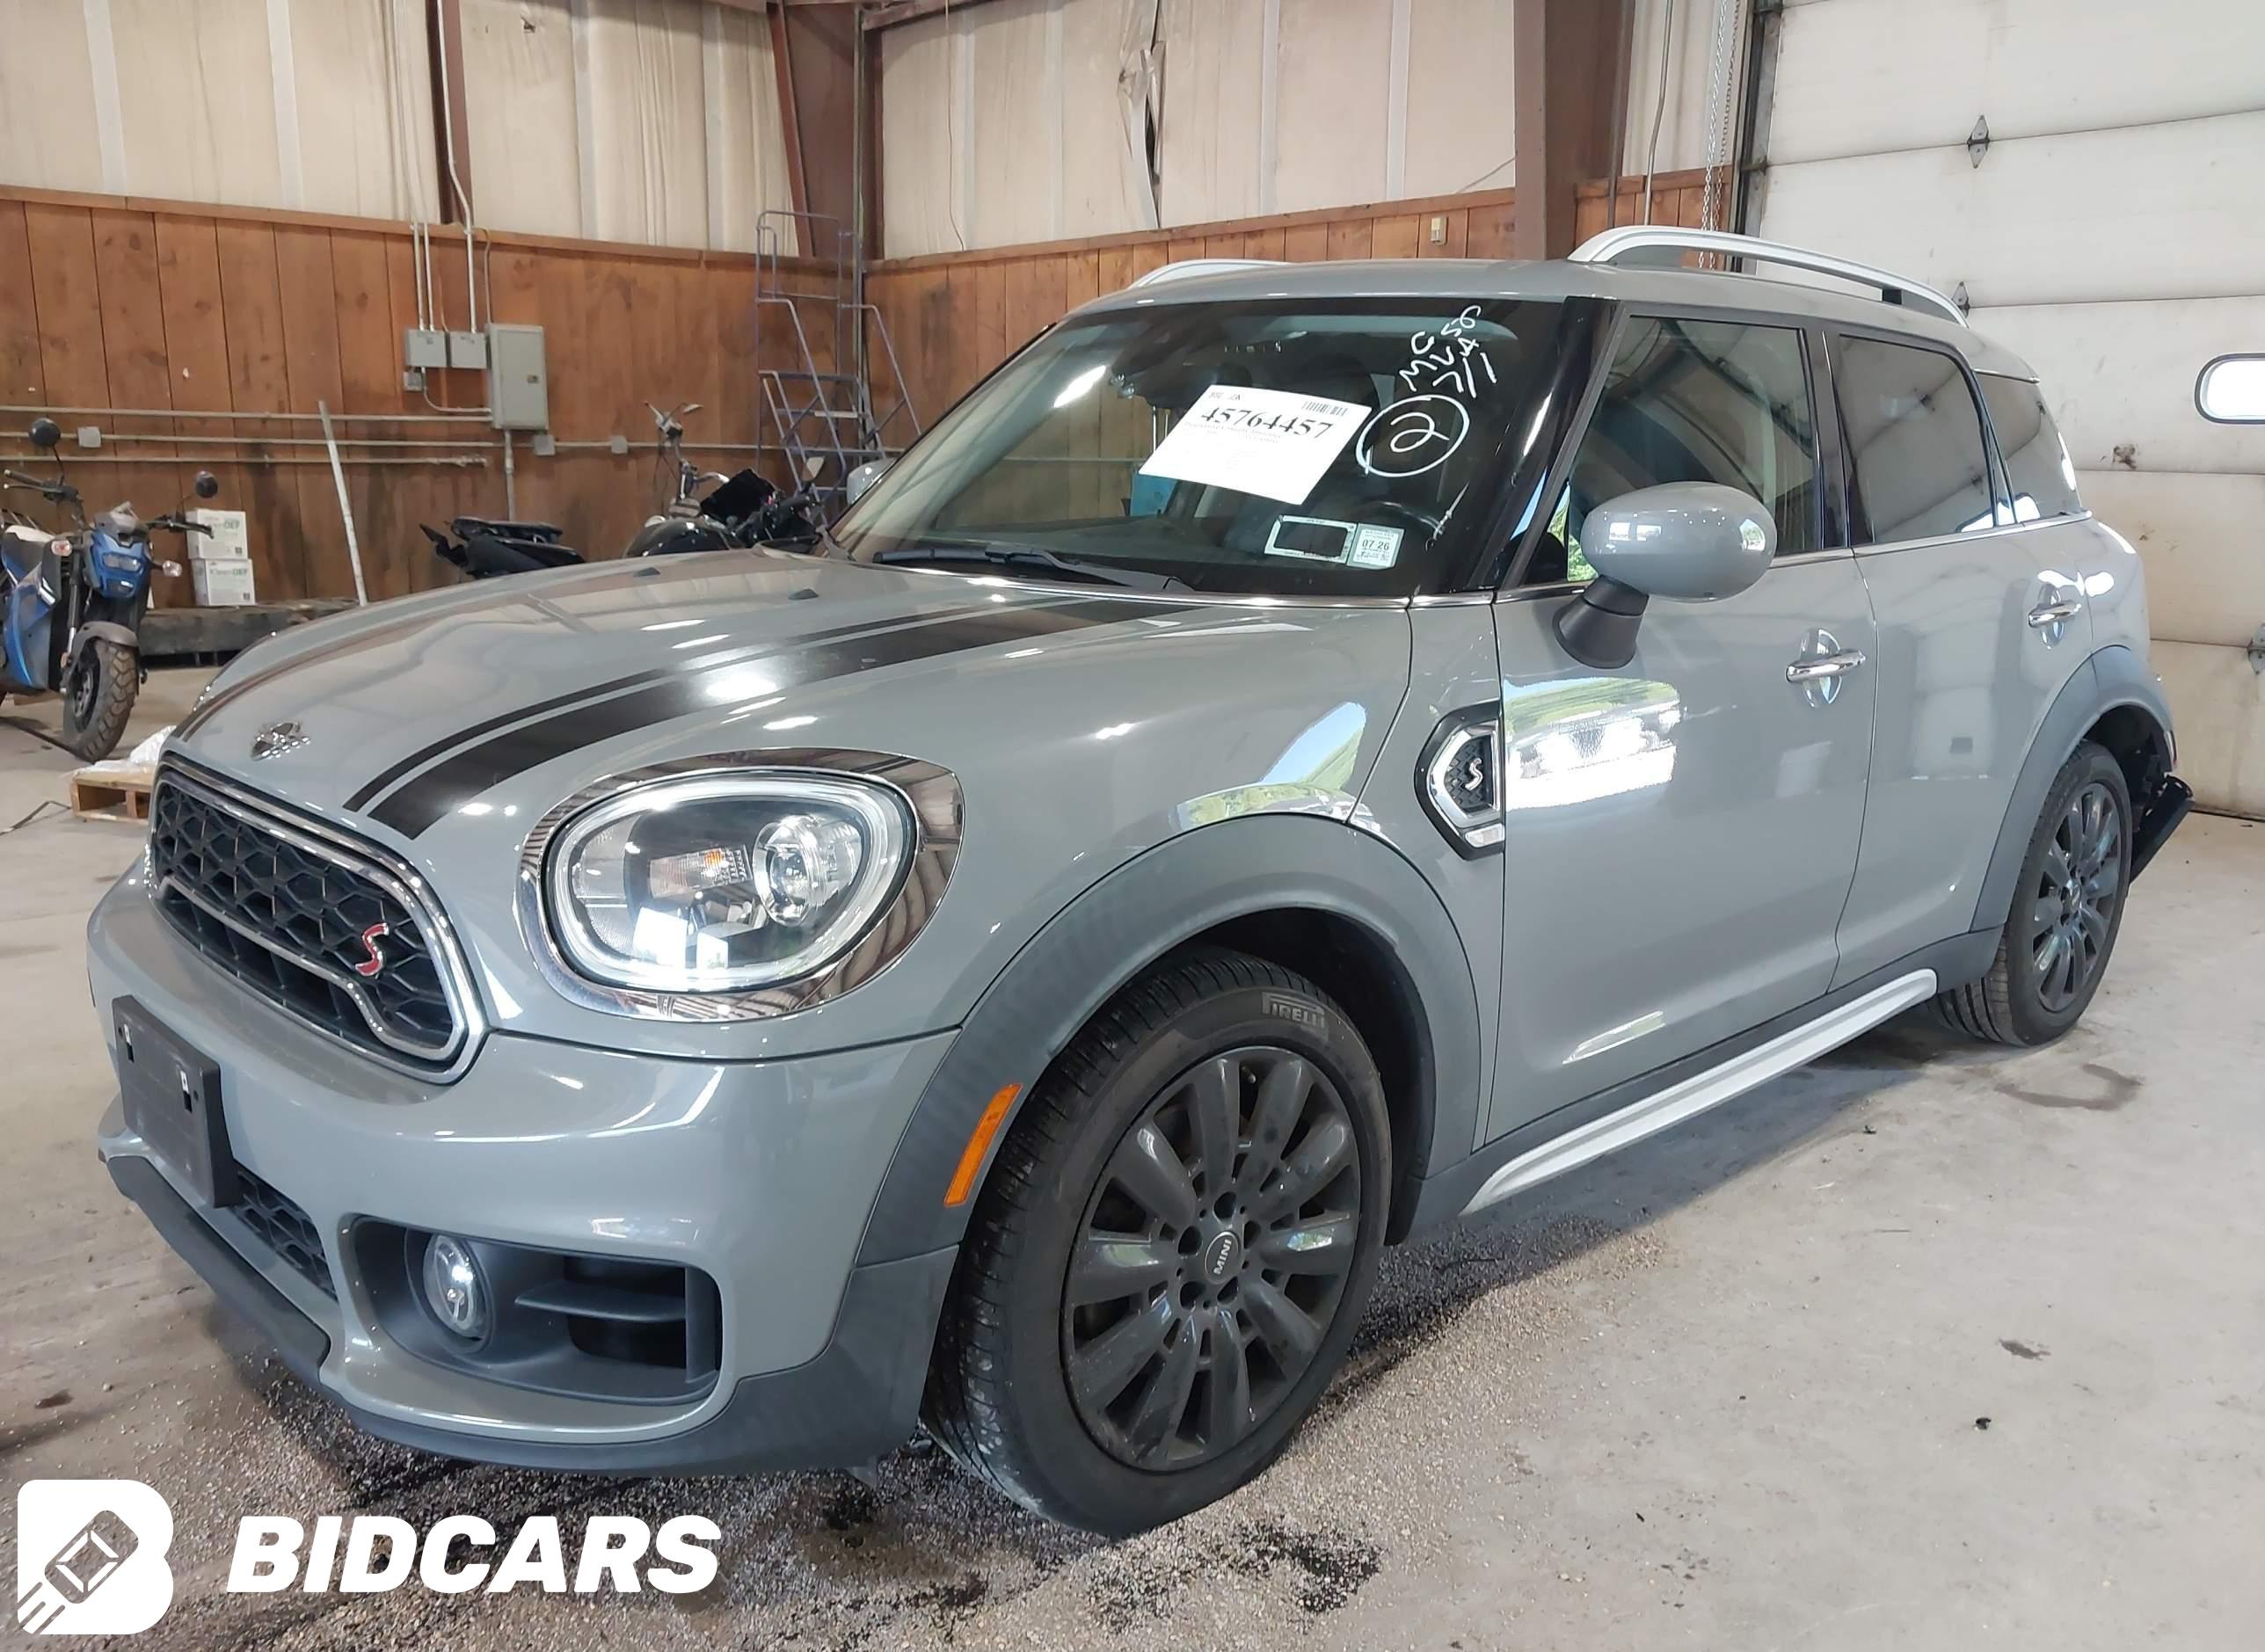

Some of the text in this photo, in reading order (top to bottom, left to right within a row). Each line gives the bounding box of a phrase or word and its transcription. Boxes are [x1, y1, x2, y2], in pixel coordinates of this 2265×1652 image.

[1200, 407, 1334, 439] 45764457
[1389, 411, 1450, 454] 2
[1377, 540, 1390, 550] 26
[1464, 757, 1483, 790] S
[354, 922, 390, 977] S
[1261, 991, 1325, 1029] PIRELLI
[1213, 1238, 1232, 1275] MINI
